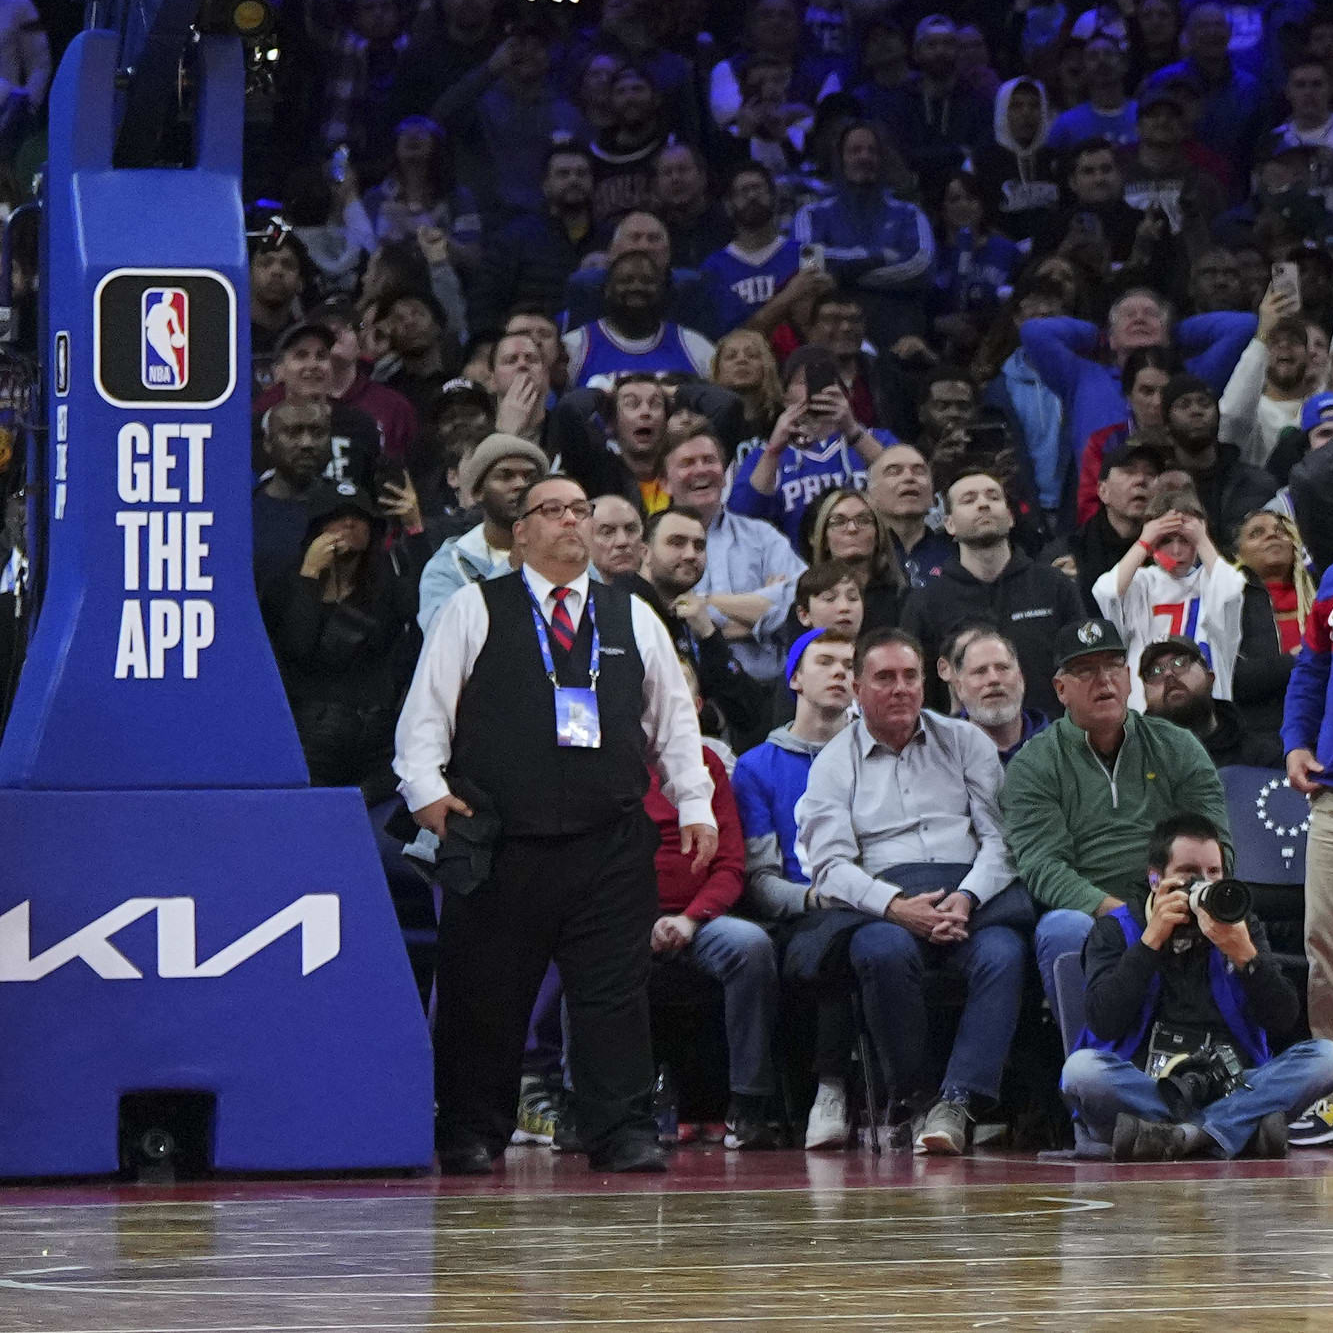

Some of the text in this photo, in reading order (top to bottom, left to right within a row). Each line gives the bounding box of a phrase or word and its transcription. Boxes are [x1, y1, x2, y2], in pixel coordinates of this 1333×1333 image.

[149, 365, 171, 383] NBA
[117, 422, 213, 504] GET
[116, 511, 214, 592] THE
[114, 599, 215, 680] APP
[0, 893, 341, 982] KIA
